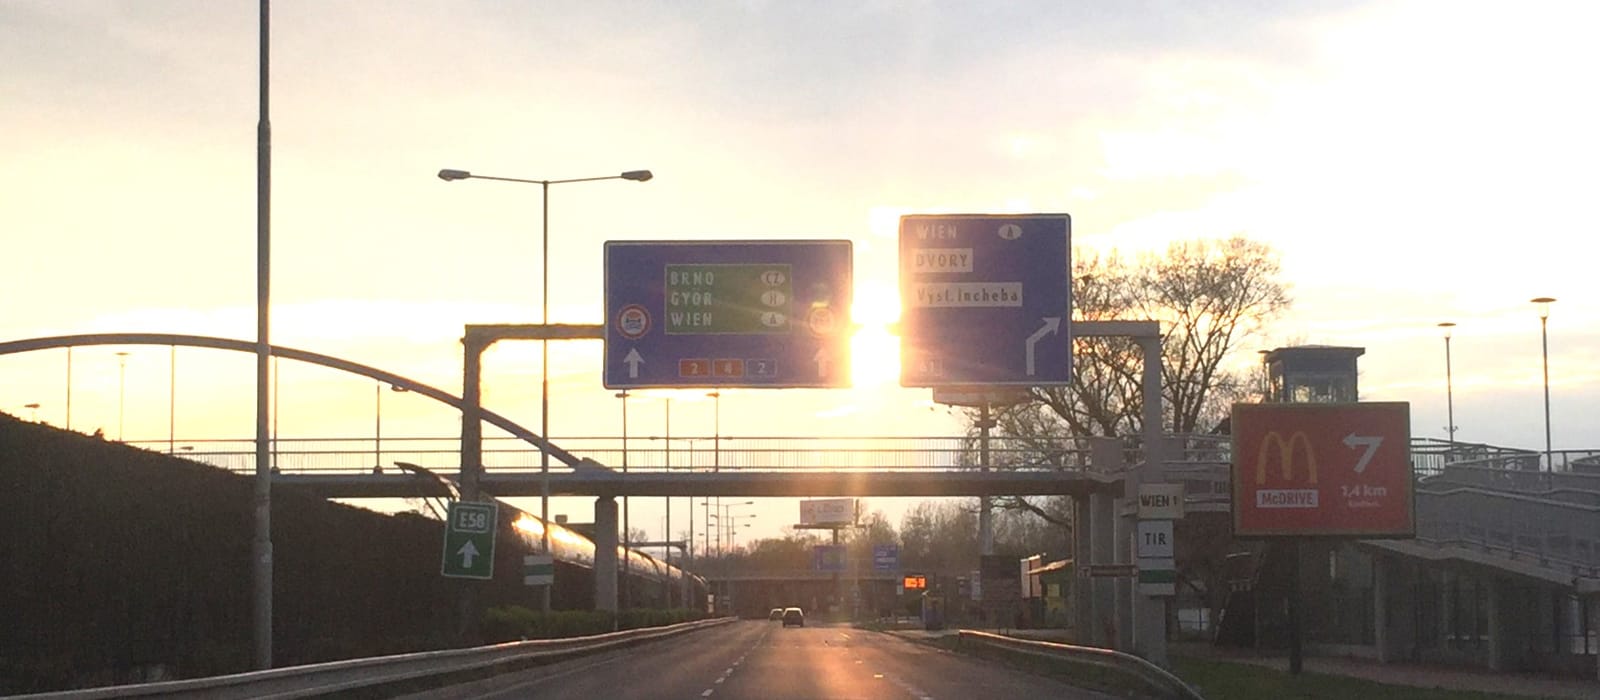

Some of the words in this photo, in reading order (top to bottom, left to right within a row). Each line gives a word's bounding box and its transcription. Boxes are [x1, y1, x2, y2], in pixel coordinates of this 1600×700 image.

[916, 225, 957, 240] WIEN
[916, 254, 968, 267] DVORY
[670, 271, 714, 286] BRNO
[766, 272, 779, 284] CZ
[670, 312, 713, 326] WIEN
[1363, 484, 1387, 497] km
[1140, 494, 1170, 507] WIEN
[1261, 492, 1314, 506] McDRIVE
[459, 511, 486, 529] E58
[1145, 532, 1167, 545] TIR
